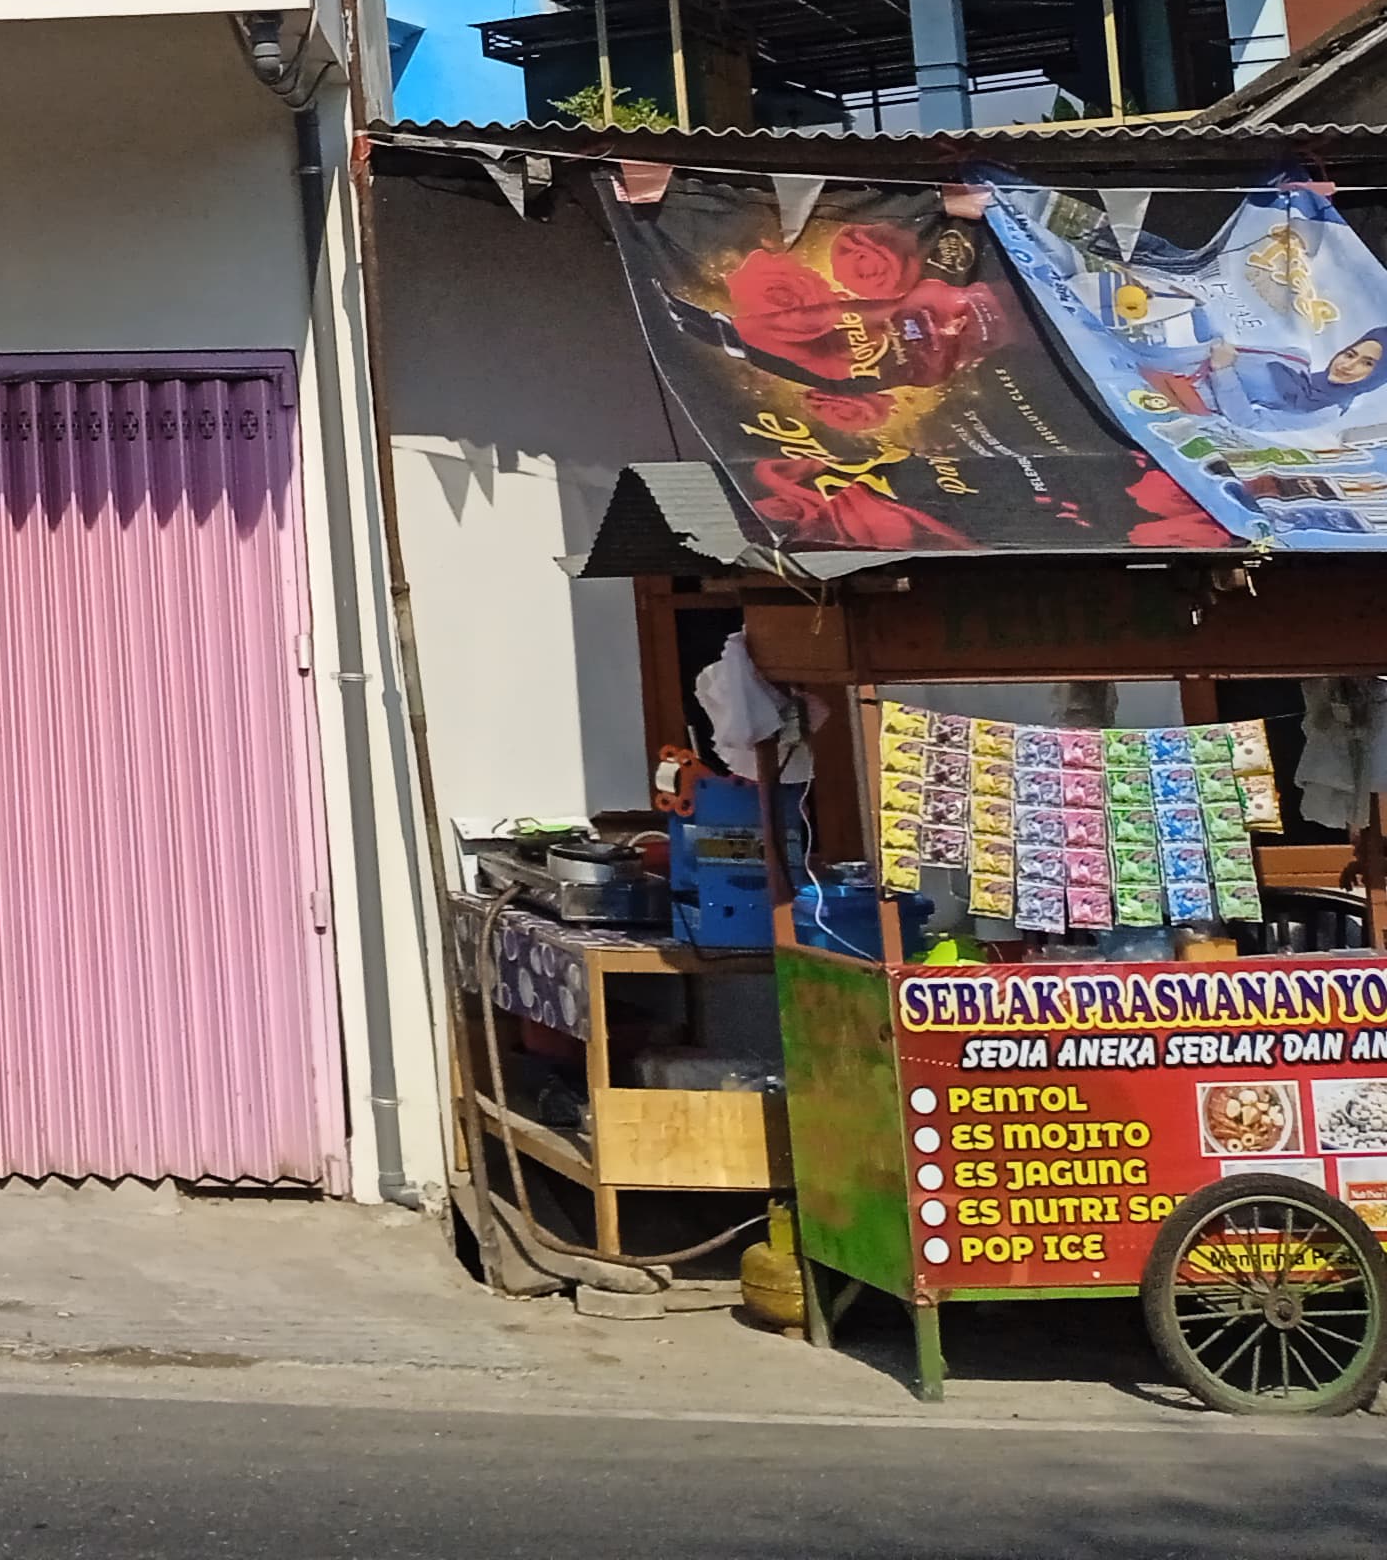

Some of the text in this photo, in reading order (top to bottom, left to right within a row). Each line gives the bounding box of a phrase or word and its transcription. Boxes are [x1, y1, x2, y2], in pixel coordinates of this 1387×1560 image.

[834, 310, 888, 380] Royale
[995, 367, 1024, 402] CLASS
[902, 977, 1062, 1029] SEBLAK
[1072, 972, 1328, 1026] PRASMANAN
[962, 1038, 1048, 1069] SEDIA
[1057, 1037, 1155, 1067] ANEKA
[1165, 1035, 1275, 1065] SEBLAK
[1282, 1032, 1345, 1062] DAN
[947, 1086, 1088, 1113] PENTOL
[950, 1121, 1151, 1151] ES MOJITO
[954, 1158, 1148, 1190] ES JAGUNG
[957, 1199, 1002, 1226] ES
[1010, 1197, 1121, 1225] NUTRI
[961, 1234, 1106, 1263] POP ICE
